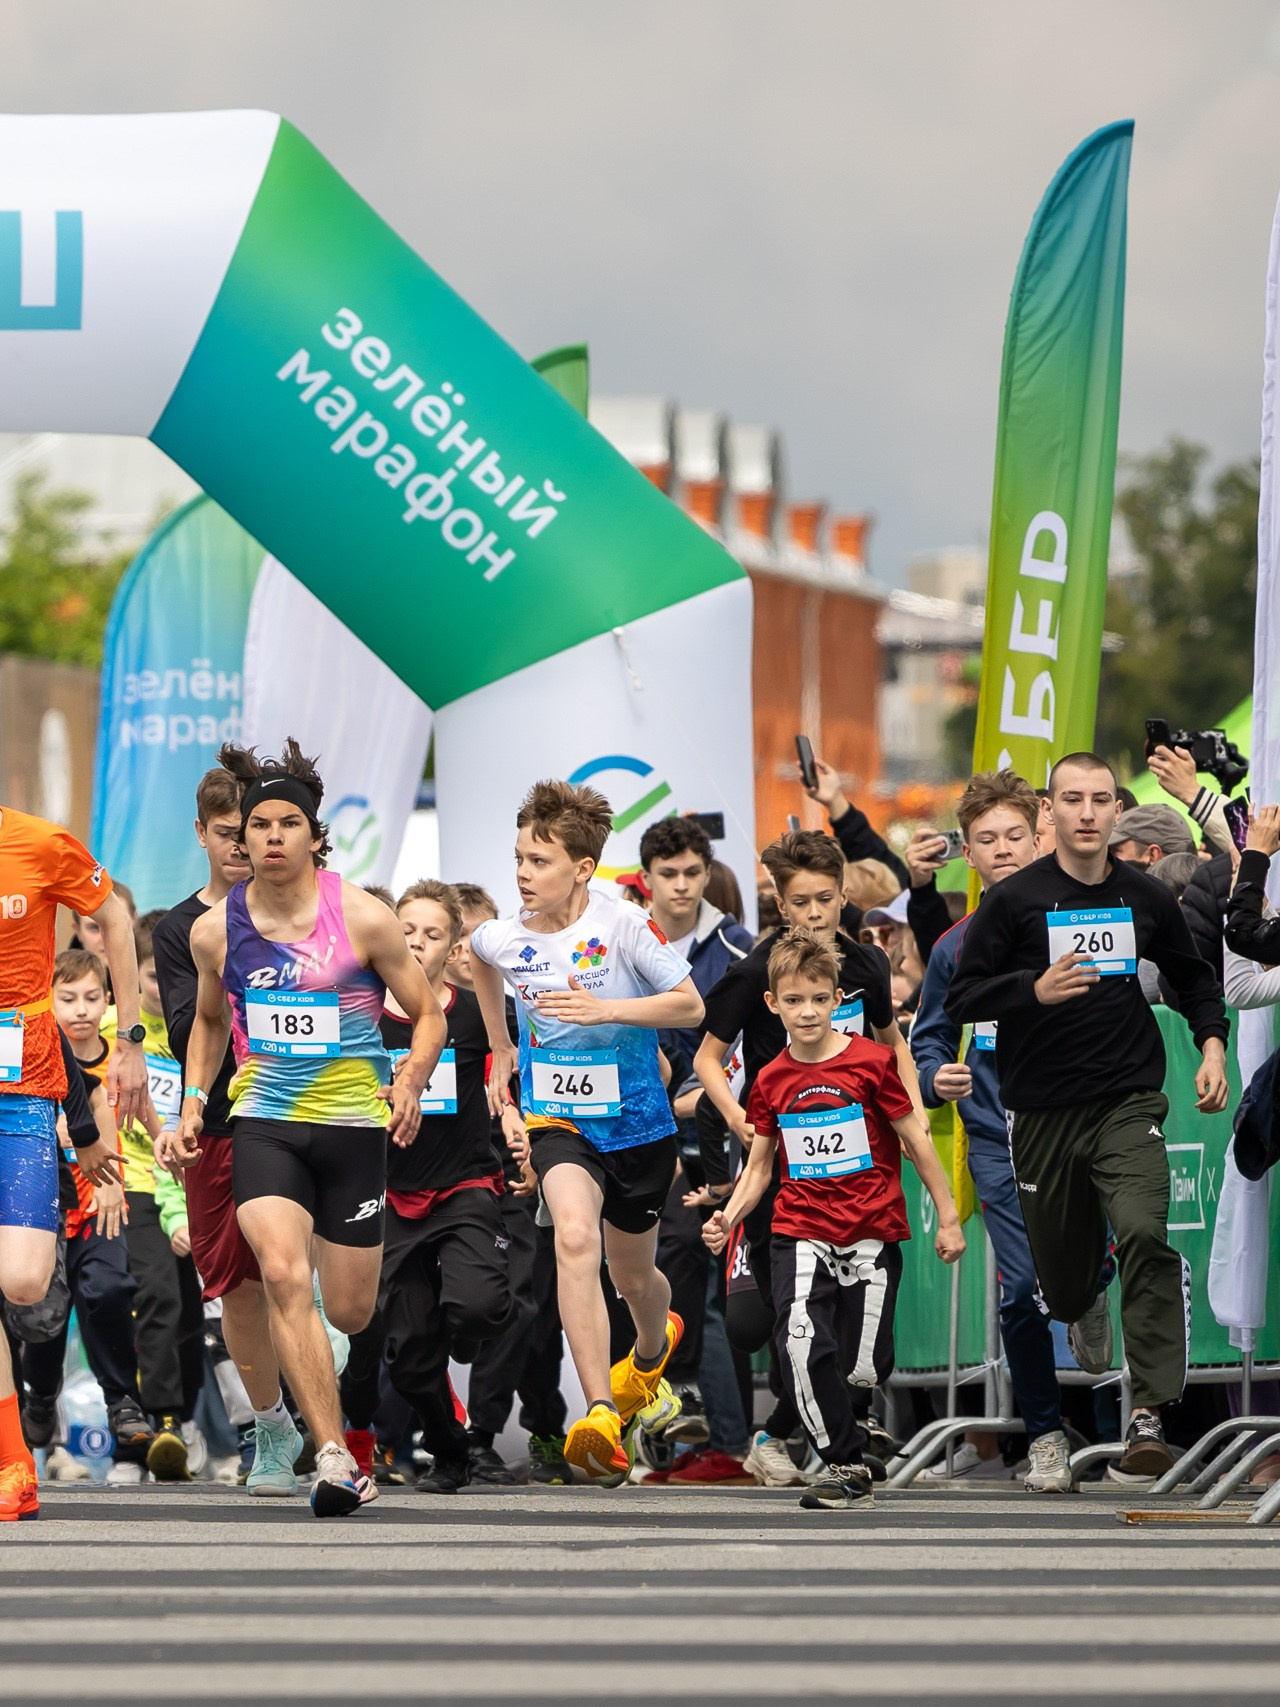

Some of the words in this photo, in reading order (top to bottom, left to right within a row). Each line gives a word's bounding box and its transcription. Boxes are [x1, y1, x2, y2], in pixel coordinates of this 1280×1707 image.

[320, 307, 567, 539] зелёный
[275, 347, 517, 582] марафон
[997, 510, 1068, 790] БЕР
[122, 657, 243, 704] зелён
[121, 704, 244, 753] мараф
[1073, 931, 1114, 954] 260
[270, 1013, 315, 1035] 183
[261, 1041, 277, 1052] 420
[150, 1076, 173, 1097] 72
[552, 1073, 594, 1096] 246
[545, 1102, 561, 1114] 420
[824, 1113, 841, 1121] KIDS
[802, 1132, 846, 1157] 342
[799, 1165, 814, 1175] 420
